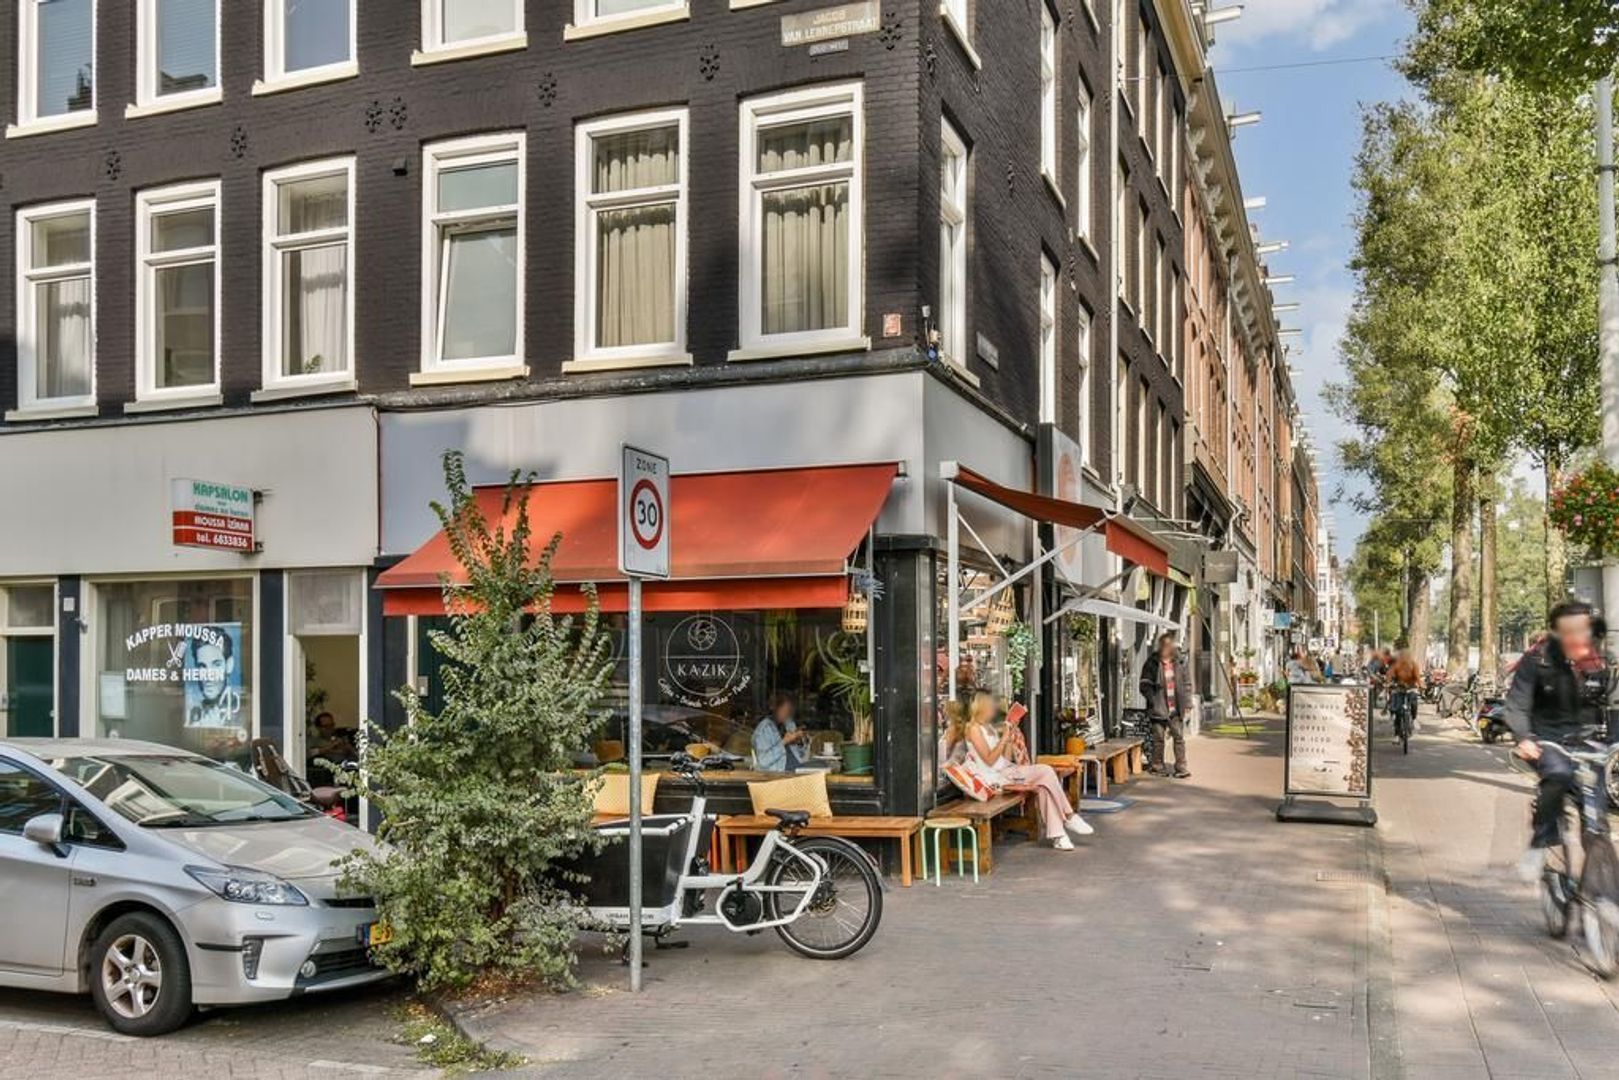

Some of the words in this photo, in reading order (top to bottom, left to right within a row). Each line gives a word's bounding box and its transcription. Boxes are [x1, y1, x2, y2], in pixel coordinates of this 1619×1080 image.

[635, 457, 657, 475] ZONE
[637, 500, 658, 527] 30
[126, 624, 172, 652] KAPPER
[175, 623, 225, 651] MOUSSA
[126, 668, 167, 681] DAMES
[170, 670, 179, 681] &
[183, 668, 224, 681] HEREN
[677, 663, 727, 677] KAZIK
